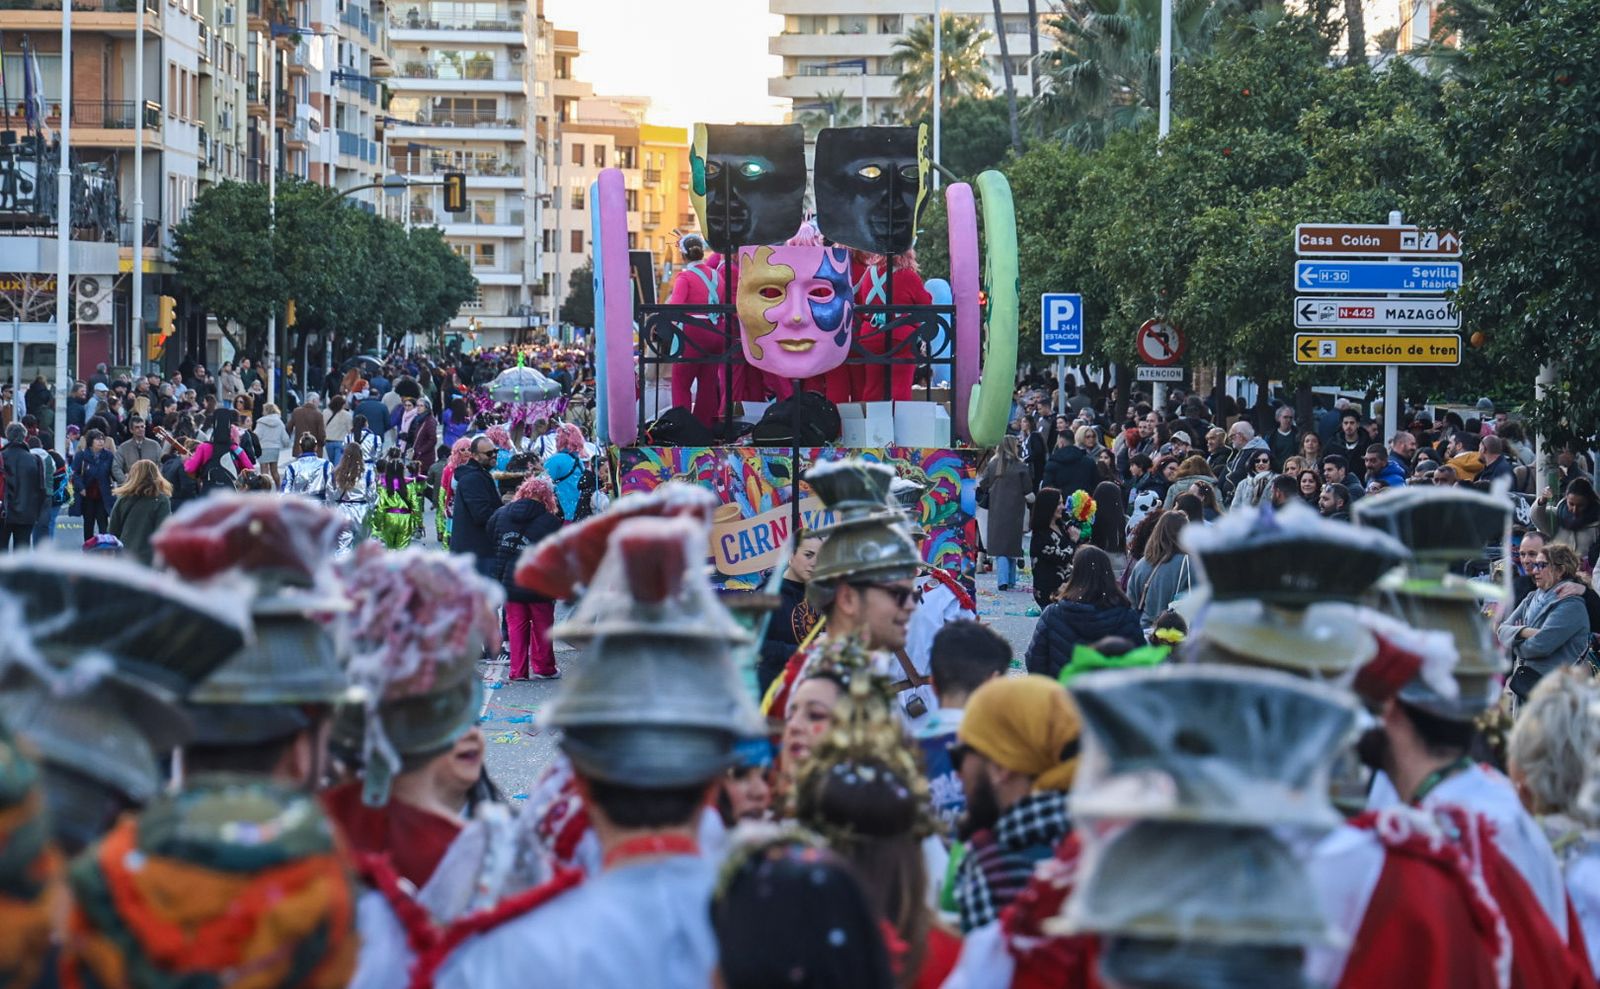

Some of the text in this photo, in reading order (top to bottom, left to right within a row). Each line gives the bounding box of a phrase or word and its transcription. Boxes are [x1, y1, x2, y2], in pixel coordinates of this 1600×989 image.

[1300, 234, 1333, 246] Casa
[1341, 234, 1381, 246] Colón
[1321, 267, 1457, 281] H-30 Sevilla
[1404, 279, 1457, 289] La Rábida
[1050, 300, 1075, 331] P
[1339, 306, 1458, 320] N-442 MAZAGÓN
[1345, 344, 1457, 355] estación de tren
[1139, 368, 1182, 377] ATENCION
[720, 509, 836, 565] CARNVA
